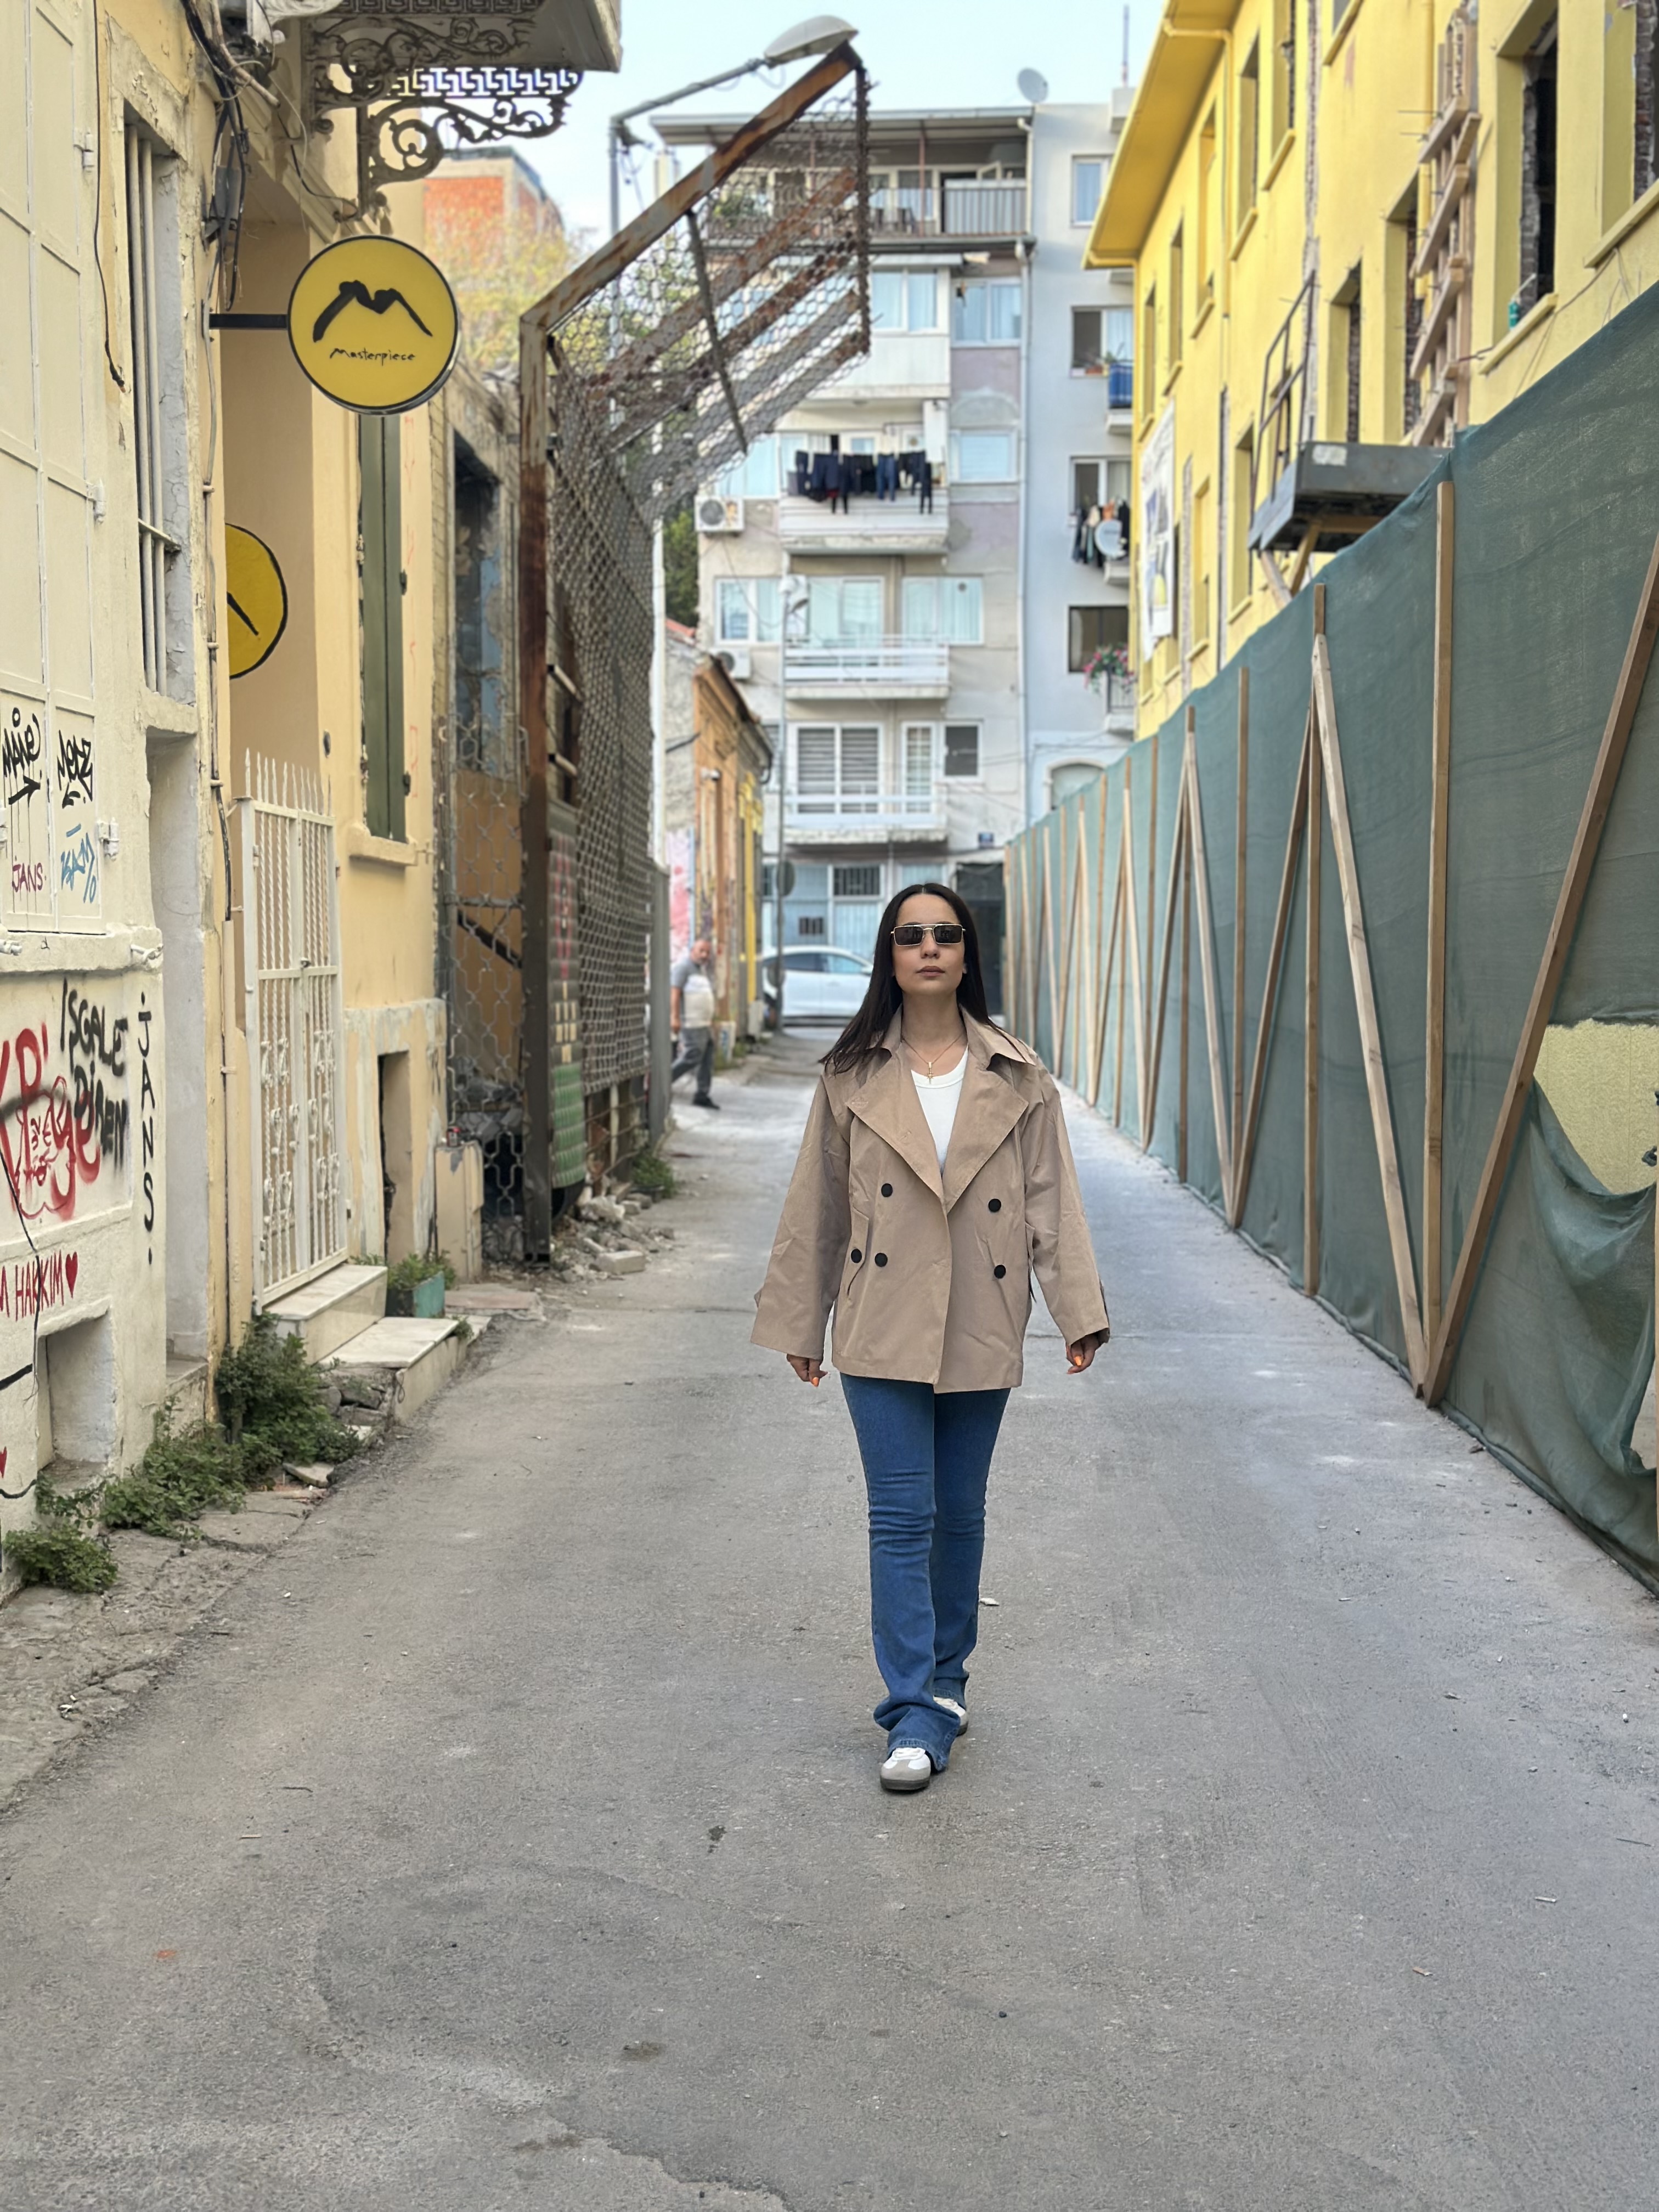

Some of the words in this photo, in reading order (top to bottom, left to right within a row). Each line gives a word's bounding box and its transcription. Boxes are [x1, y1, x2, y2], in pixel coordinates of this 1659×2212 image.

[329, 348, 415, 366] Masterpiece
[12, 862, 43, 893] JANS
[15, 1249, 64, 1323] HAKKIM
